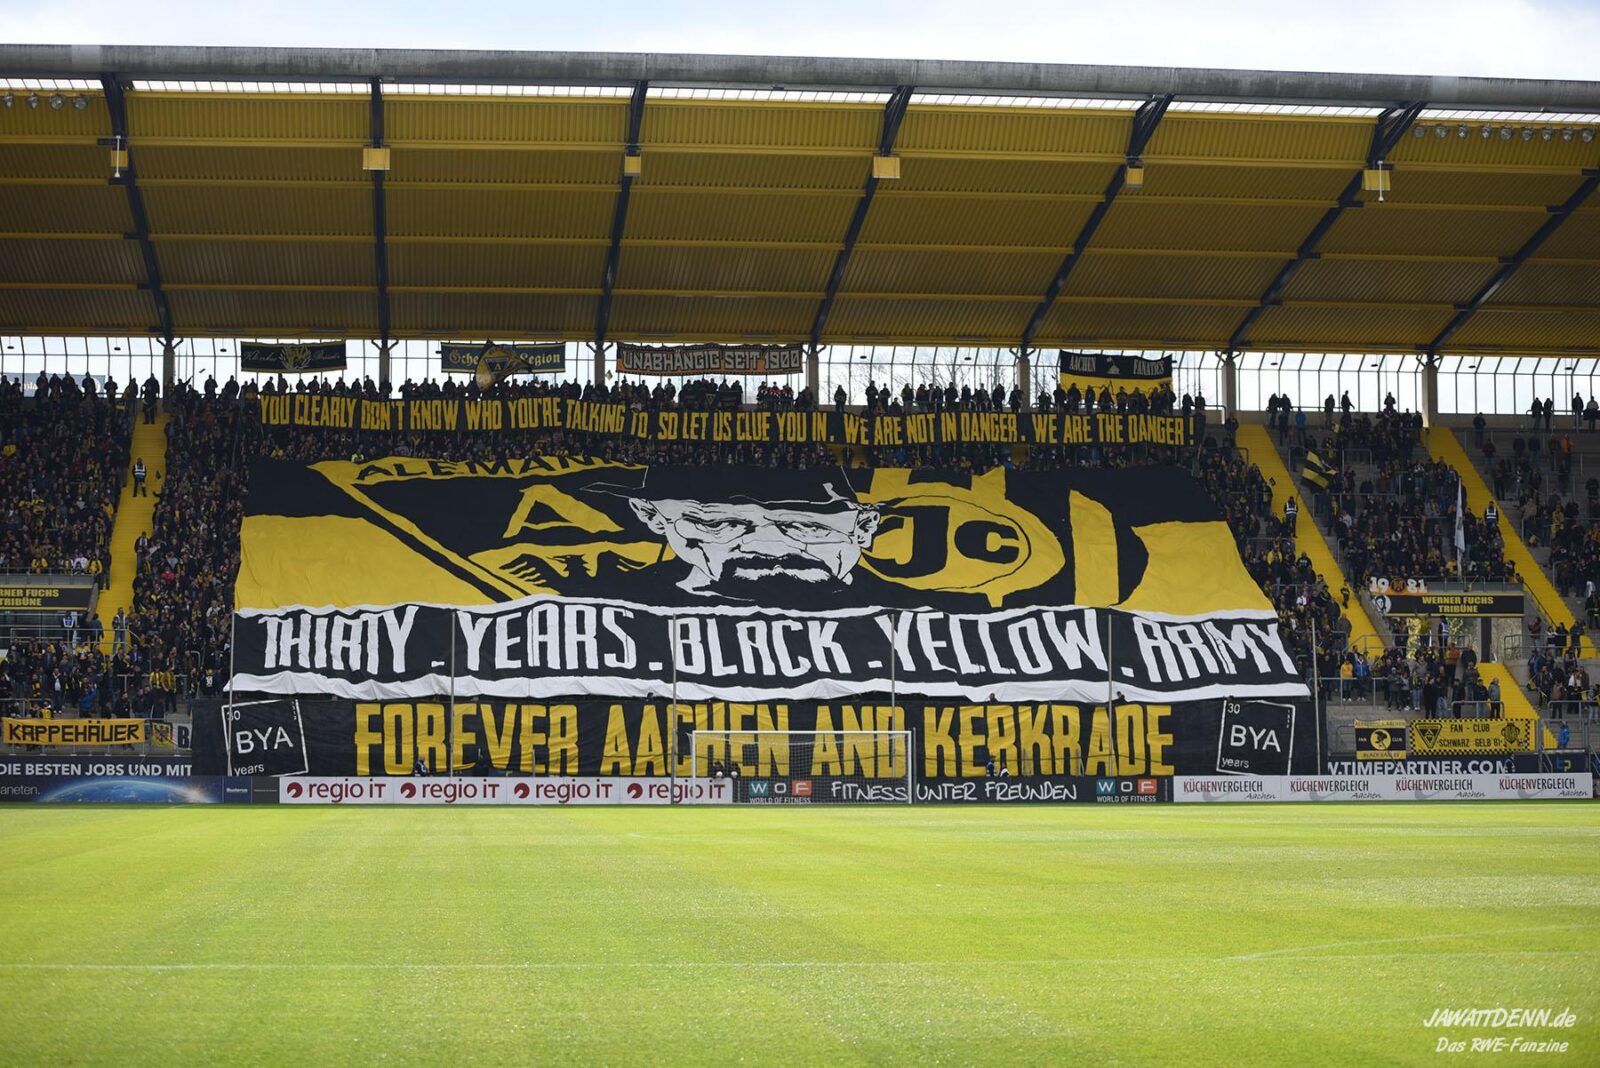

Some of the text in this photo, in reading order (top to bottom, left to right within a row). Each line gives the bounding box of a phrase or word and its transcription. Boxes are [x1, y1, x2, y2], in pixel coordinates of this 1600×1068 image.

[449, 349, 480, 366] Öche
[622, 348, 801, 369] UNABHÄNGIG SEIT 1900
[260, 396, 290, 425] YOU
[294, 394, 357, 428] CLEARLY
[361, 399, 404, 430] DON'T
[410, 400, 459, 431] KNOW
[465, 400, 503, 431] WHO
[507, 397, 562, 429] YOU'RE
[565, 398, 626, 433] TALKING
[657, 411, 678, 441] SO
[681, 411, 709, 441] LET
[712, 411, 732, 442] US
[736, 411, 770, 442] CLUE
[776, 411, 807, 442] YOU
[843, 412, 869, 446] WE
[874, 415, 903, 446] ARE
[906, 413, 936, 444] NOT
[940, 411, 958, 443] IN
[1031, 413, 1058, 444] WE
[1063, 415, 1093, 445] ARE
[1096, 413, 1124, 444] THE
[25, 588, 60, 597] FUCHS
[1422, 596, 1495, 605] WERNER FUCHS
[1438, 604, 1479, 613] TRIBÜNE
[258, 605, 420, 675] THIRTY
[456, 603, 637, 671] YEARS
[667, 616, 852, 678] BLACK
[873, 608, 1109, 675] YELLOW
[1132, 616, 1299, 683] ARMY
[1227, 702, 1241, 715] 30
[9, 720, 141, 743] KAPPEHÄUER
[1450, 723, 1463, 733] FAN
[1472, 723, 1490, 733] CLUB
[235, 726, 294, 755] BYA
[354, 702, 1175, 779] FOREVER AACHEN AND KERKRADE
[1229, 724, 1282, 753] BYA
[1439, 738, 1470, 748] SCHWARZ
[0, 764, 192, 777] DIE BESTEN JOBS UND MIT
[234, 763, 265, 776] years
[1220, 756, 1250, 770] years
[307, 778, 363, 803] regio
[421, 778, 477, 803] regio
[535, 778, 590, 803] regio
[1183, 778, 1263, 793] KÜCHENVERGLEICH
[1290, 778, 1369, 793] KÜCHENVERGLEICH
[1395, 777, 1473, 791] KÜCHENVERGLEICH
[1499, 776, 1576, 790] KÜCHENVERGLEICH
[831, 781, 1077, 801] FITNESS UNTER FREUNDEN
